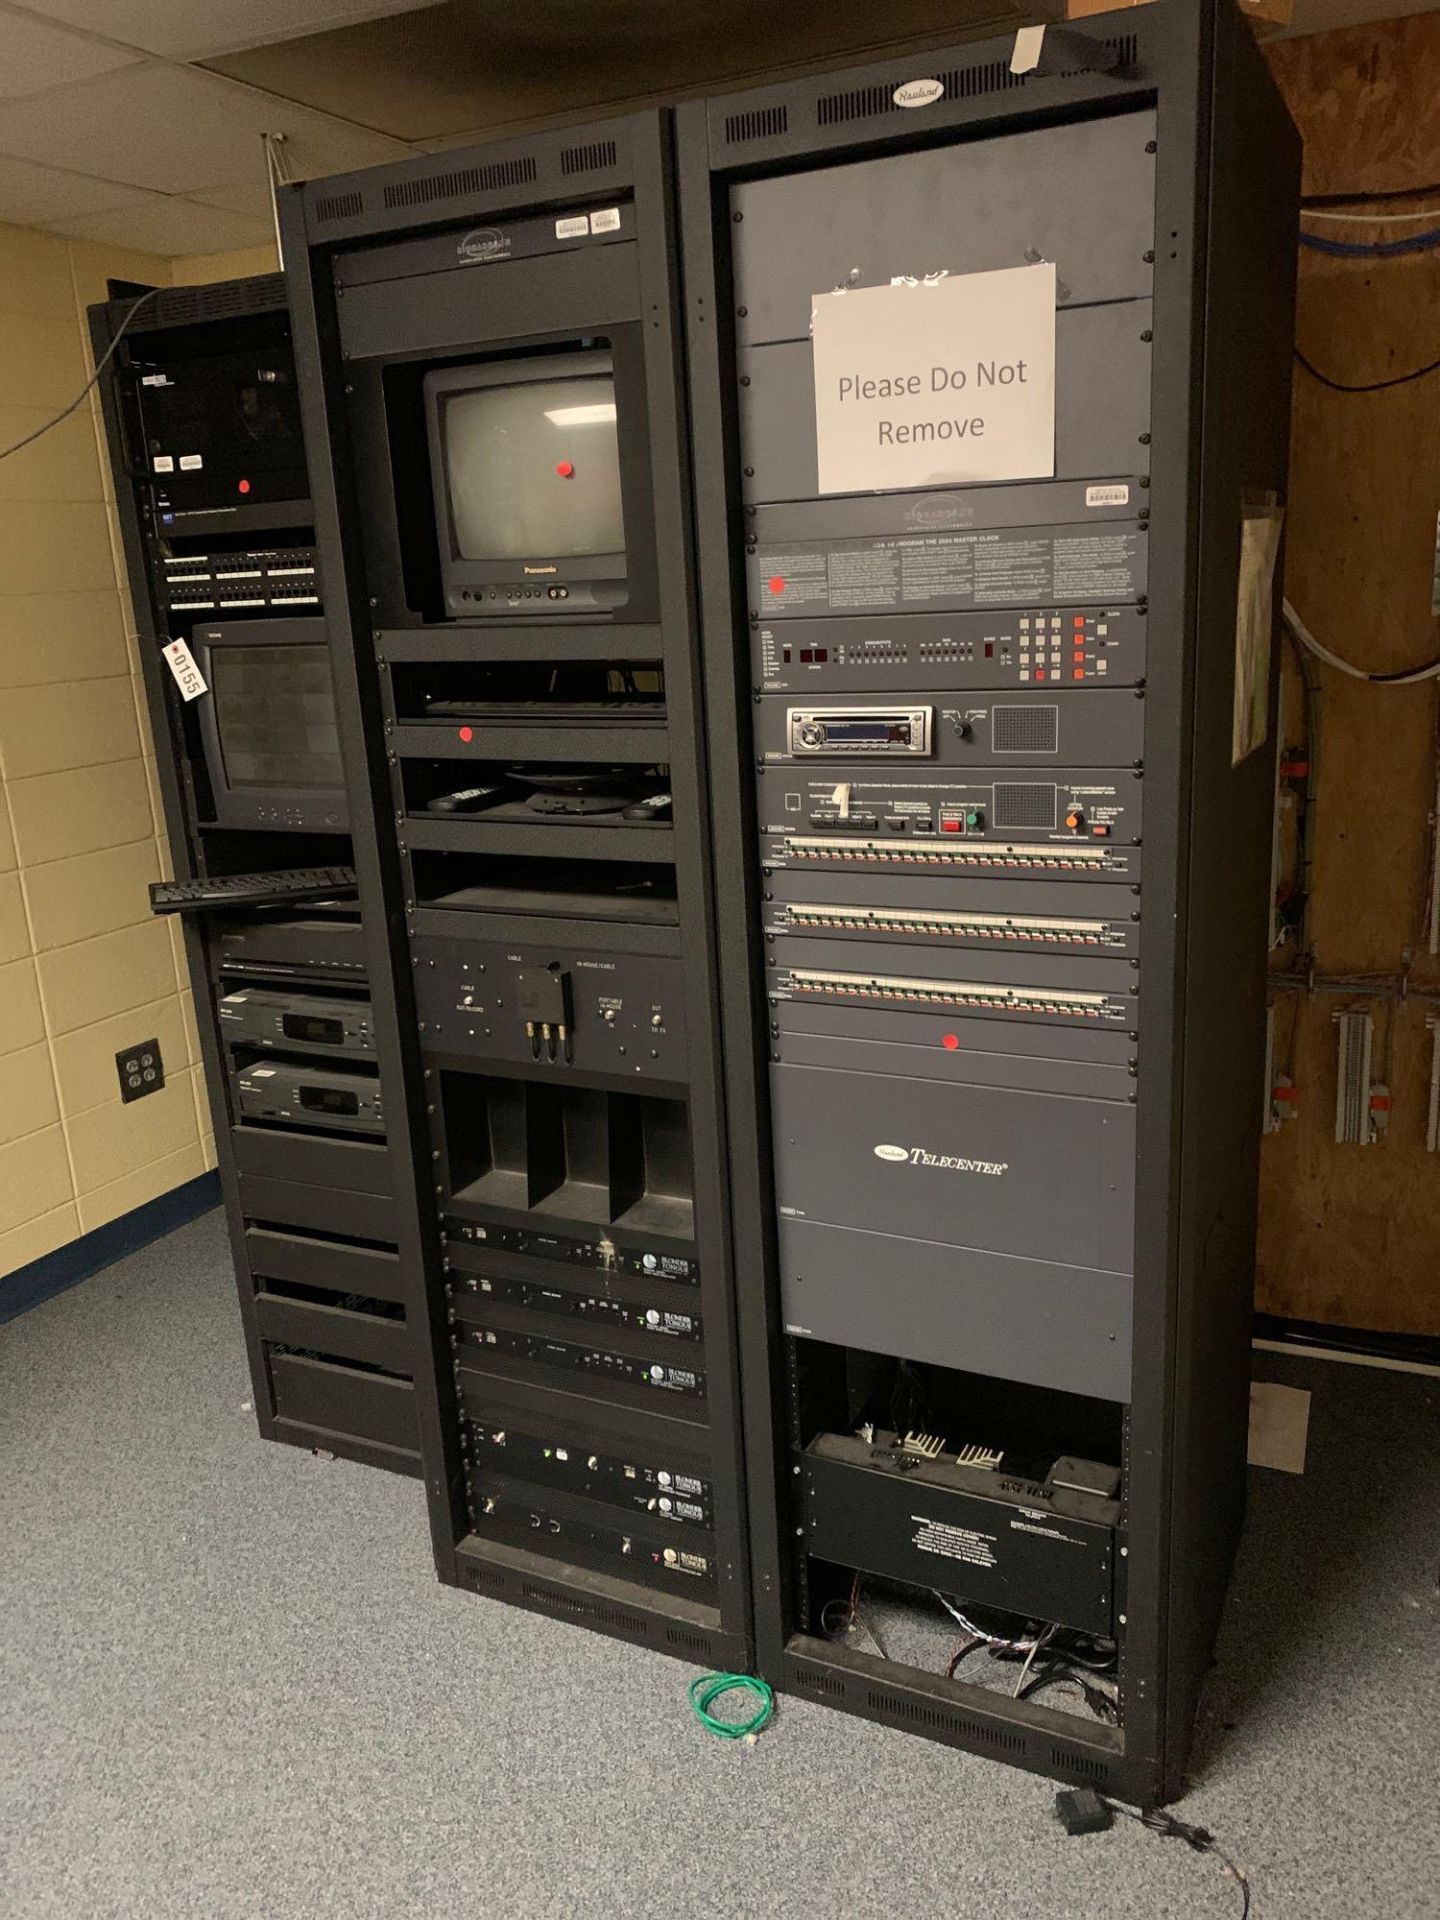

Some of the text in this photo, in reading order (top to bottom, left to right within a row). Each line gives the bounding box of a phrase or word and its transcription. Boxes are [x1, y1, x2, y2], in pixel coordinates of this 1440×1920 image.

[838, 359, 1027, 402] Please Do Not
[878, 417, 985, 446] Remove
[523, 566, 558, 575] Panasonic
[173, 654, 201, 694] 0155
